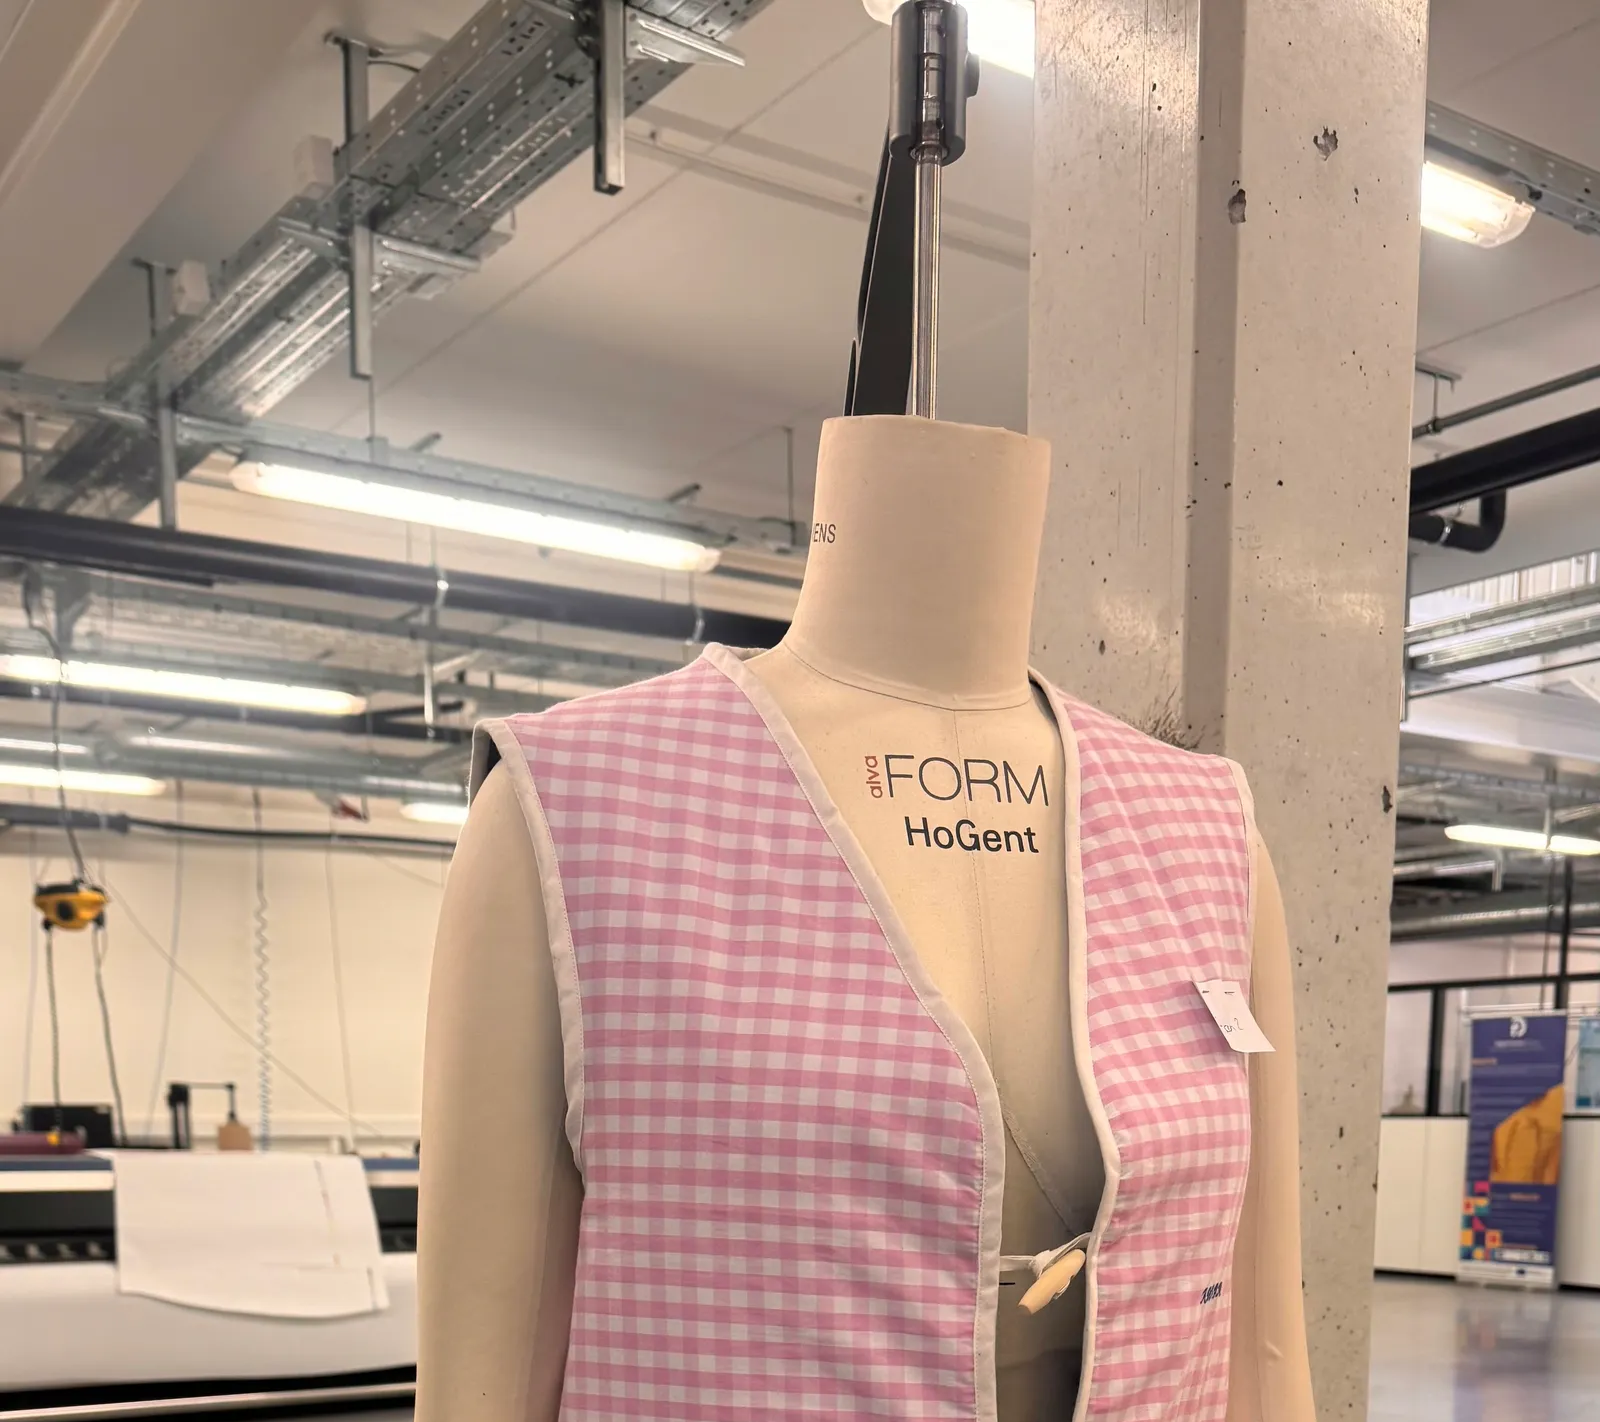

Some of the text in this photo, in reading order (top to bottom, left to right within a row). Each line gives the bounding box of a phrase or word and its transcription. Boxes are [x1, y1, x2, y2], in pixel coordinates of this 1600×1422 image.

[812, 522, 837, 544] ENS
[865, 755, 883, 799] alva
[884, 754, 1050, 807] FORM
[904, 816, 1040, 854] HoGent
